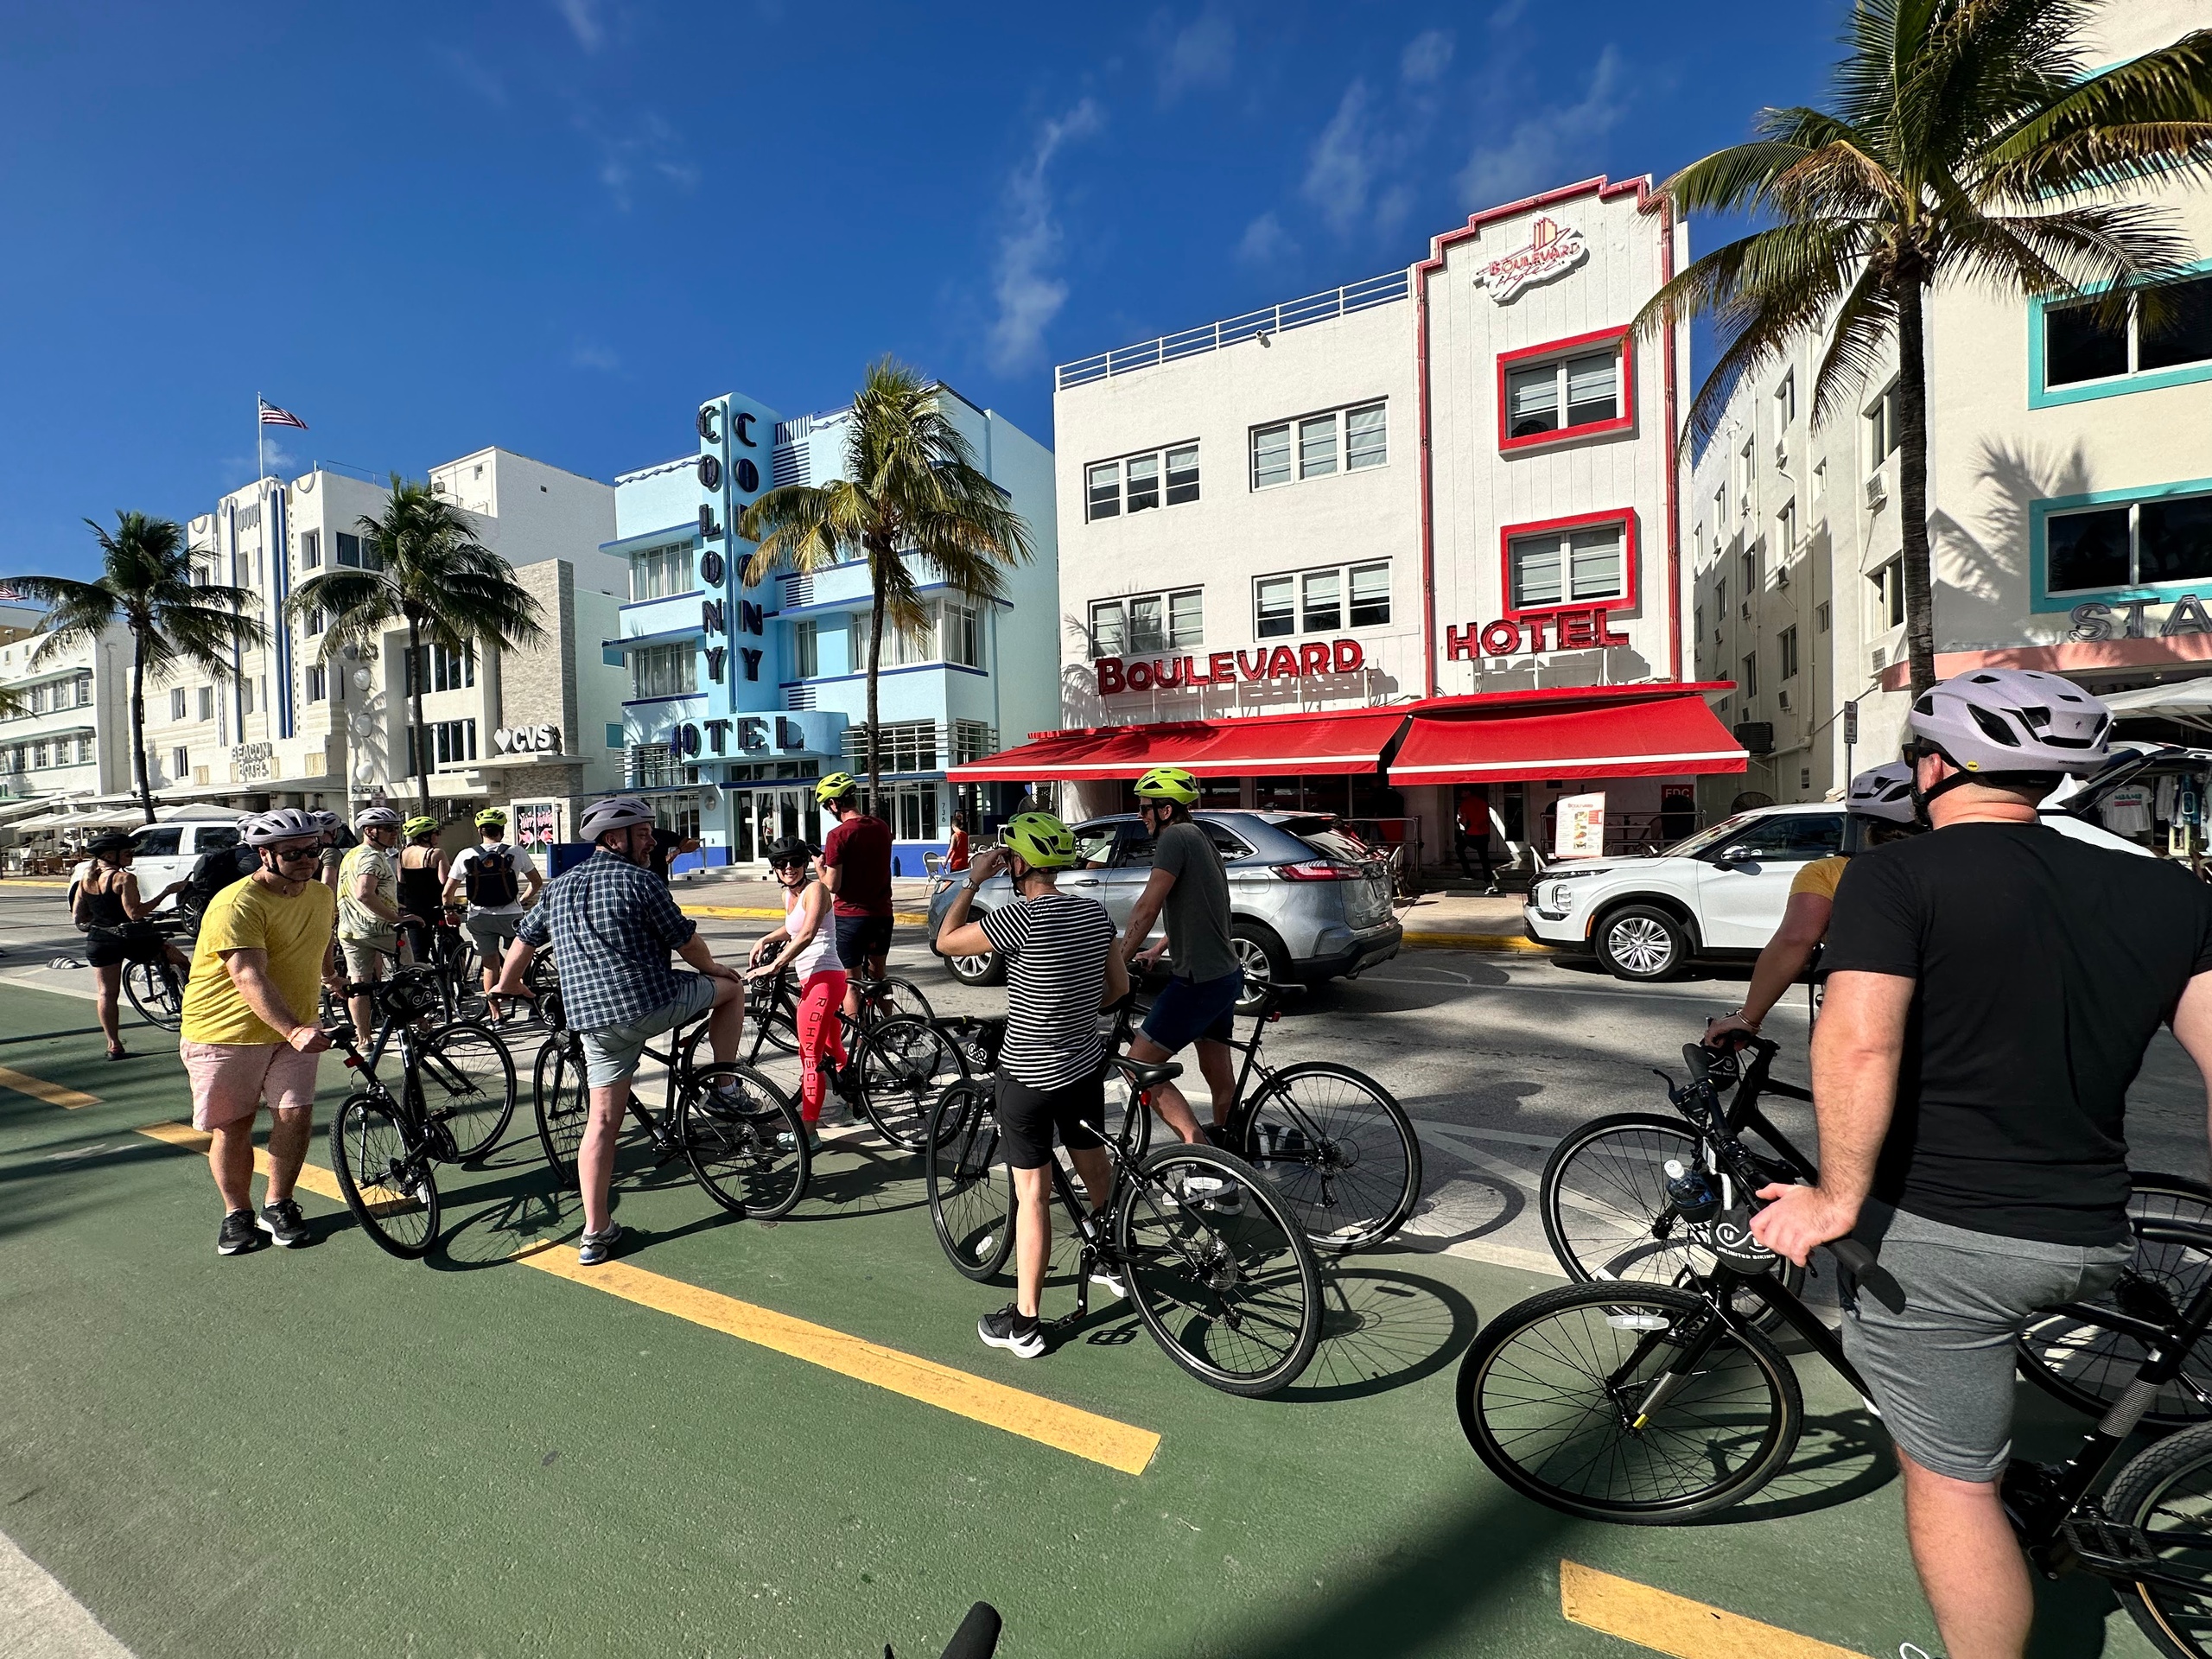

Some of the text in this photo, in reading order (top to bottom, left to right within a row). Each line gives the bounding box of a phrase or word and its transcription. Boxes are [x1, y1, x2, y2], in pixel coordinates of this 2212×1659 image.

[1489, 242, 1580, 276] BOULEVARD
[696, 405, 723, 680] COLONY
[1446, 608, 1630, 661] HOTEL
[2068, 594, 2212, 643] STA
[1095, 639, 1365, 695] BOULEVARD
[232, 742, 272, 760] BEACON
[512, 723, 552, 751] CVS
[806, 997, 828, 1097] RÖHNISCH
[1716, 1246, 1751, 1259] UNLIMITED
